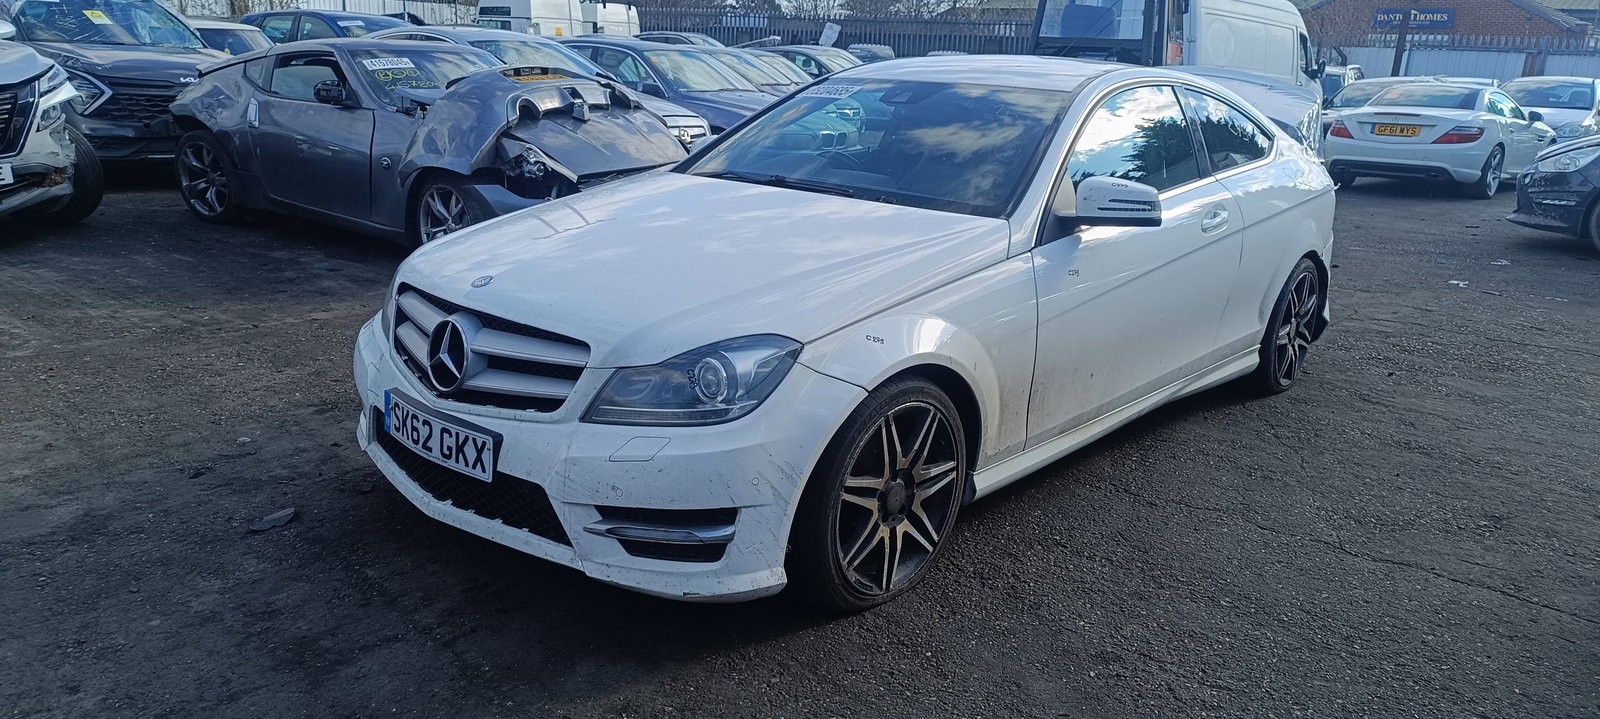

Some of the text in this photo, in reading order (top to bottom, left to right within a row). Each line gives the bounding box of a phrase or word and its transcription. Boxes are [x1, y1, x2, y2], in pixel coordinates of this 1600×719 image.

[1416, 13, 1448, 21] HOMES
[1378, 125, 1417, 135] GF61 WYS
[393, 401, 433, 454] SK62
[440, 426, 487, 474] GKX
